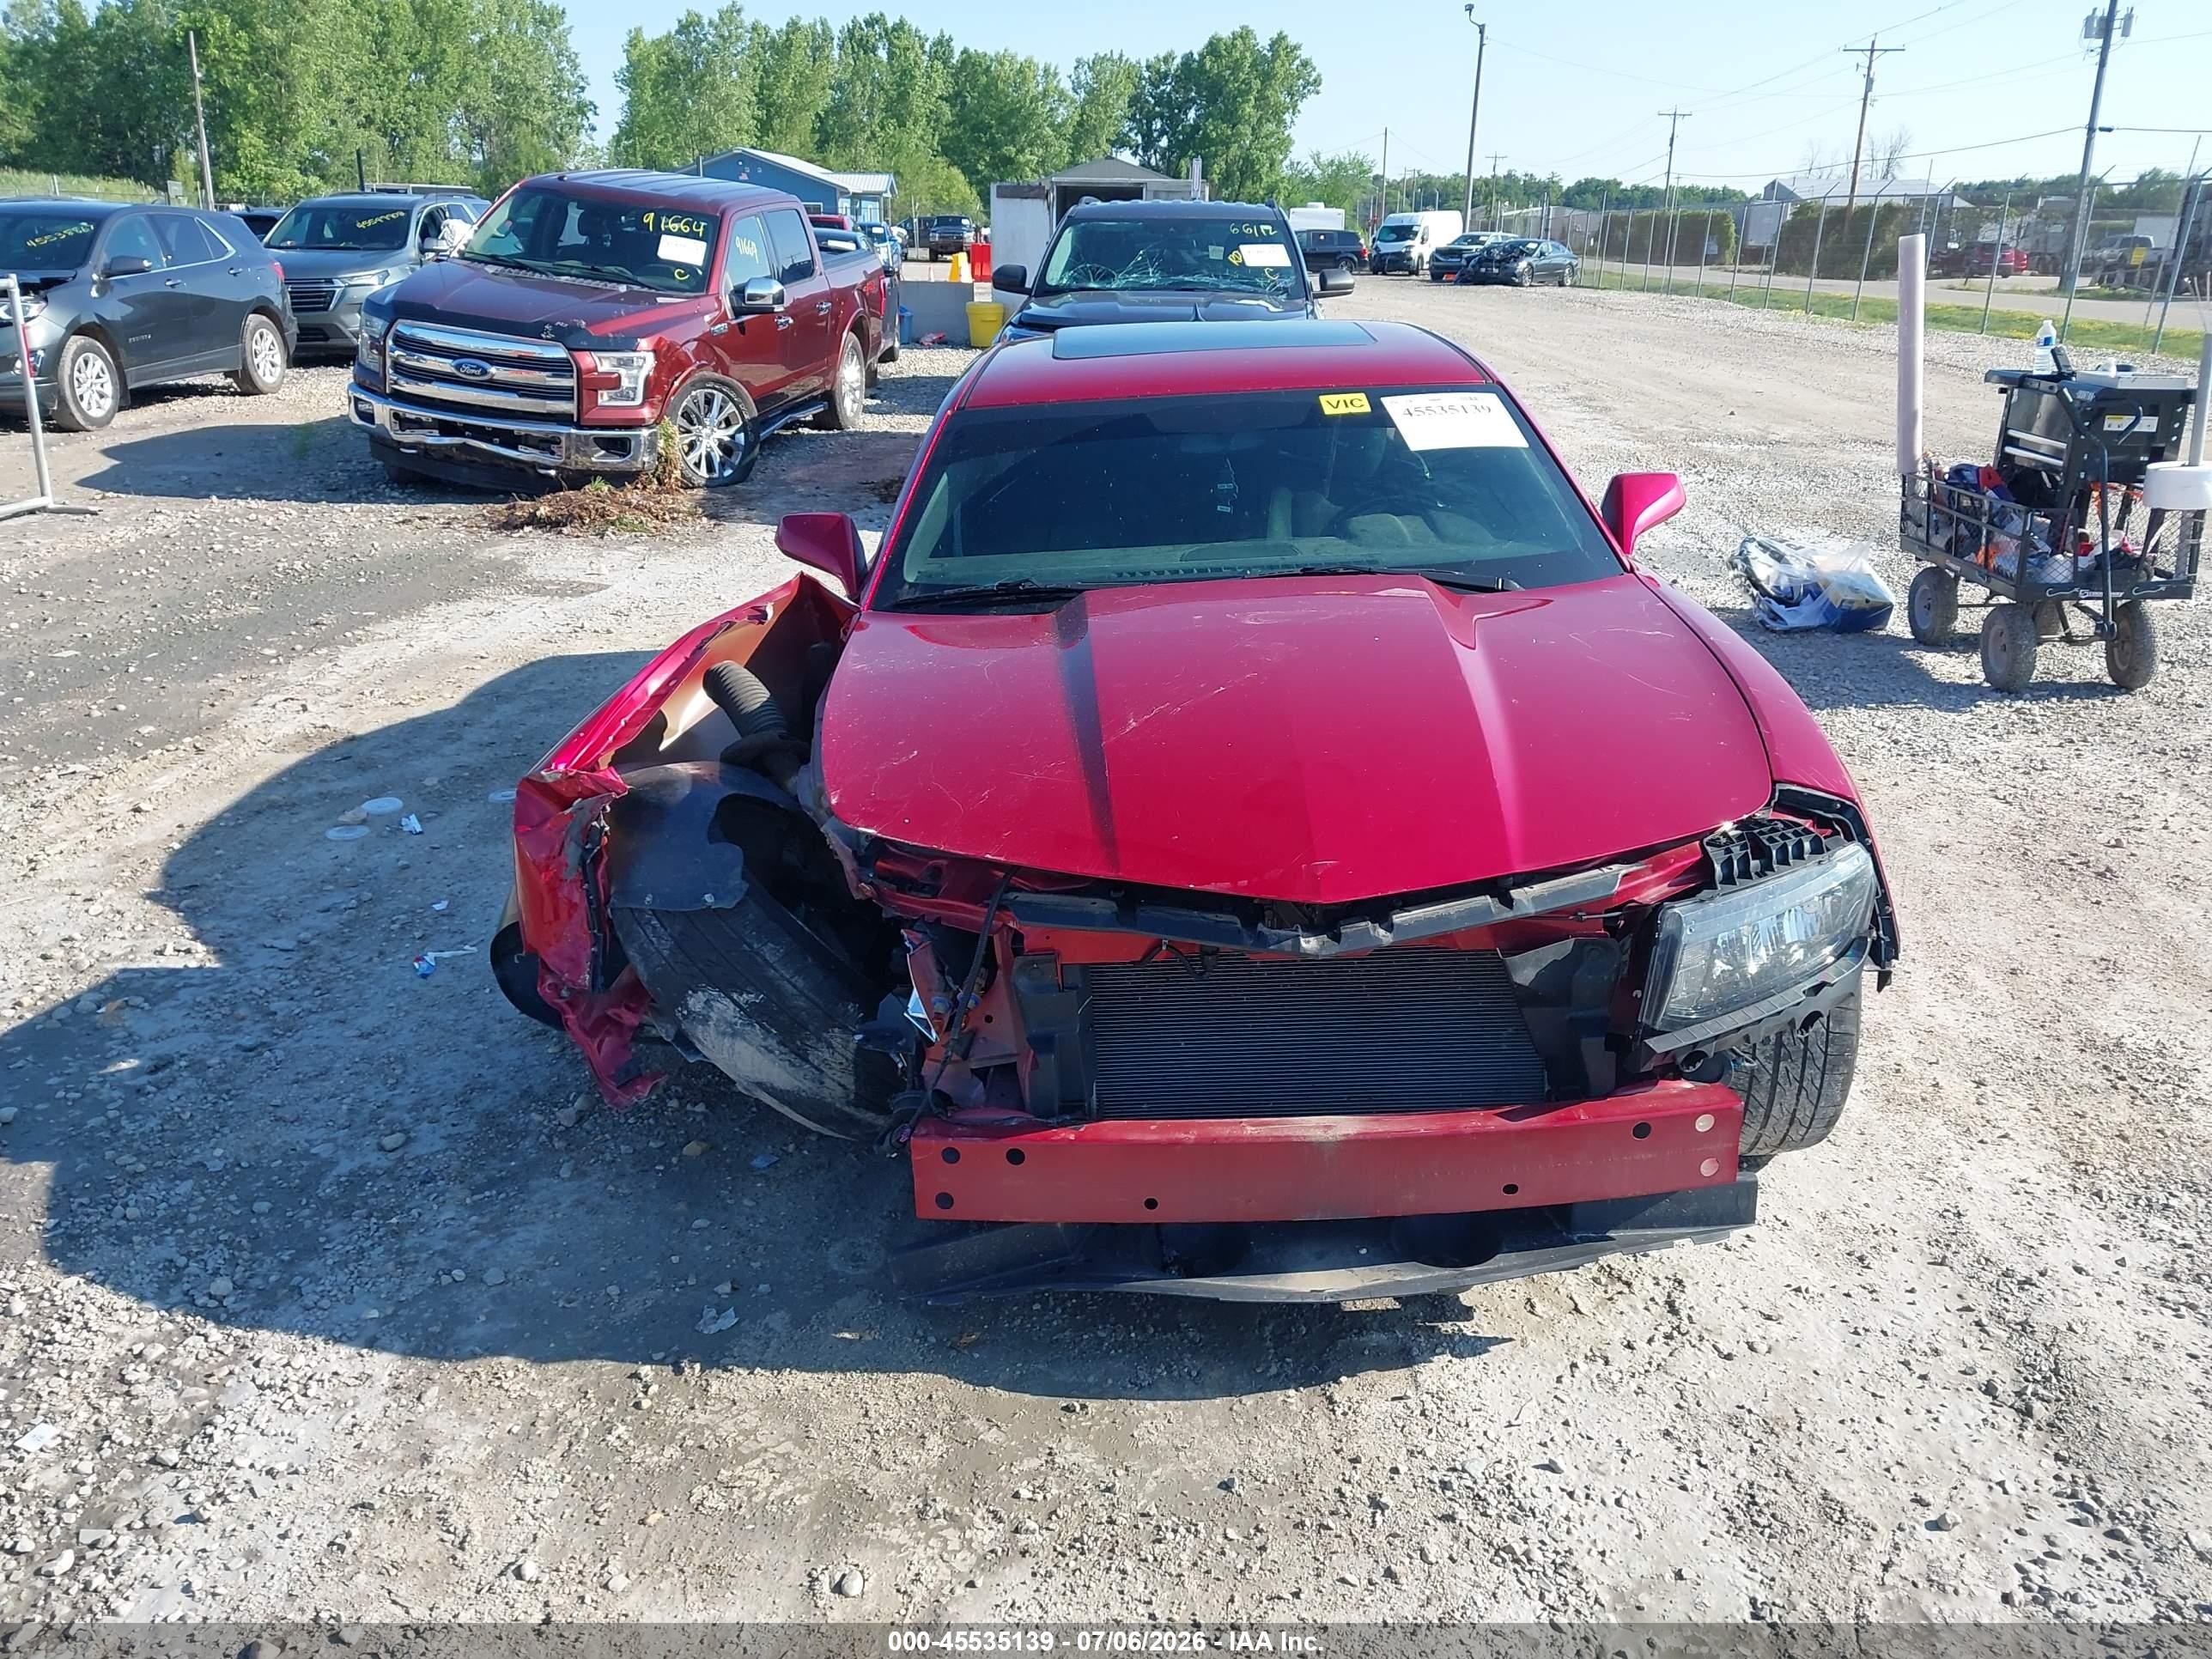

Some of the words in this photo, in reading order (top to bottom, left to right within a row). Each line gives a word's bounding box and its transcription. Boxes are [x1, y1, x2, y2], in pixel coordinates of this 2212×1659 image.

[459, 363, 483, 375] Ford
[1326, 398, 1365, 410] VIC
[1402, 404, 1492, 418] 45535139
